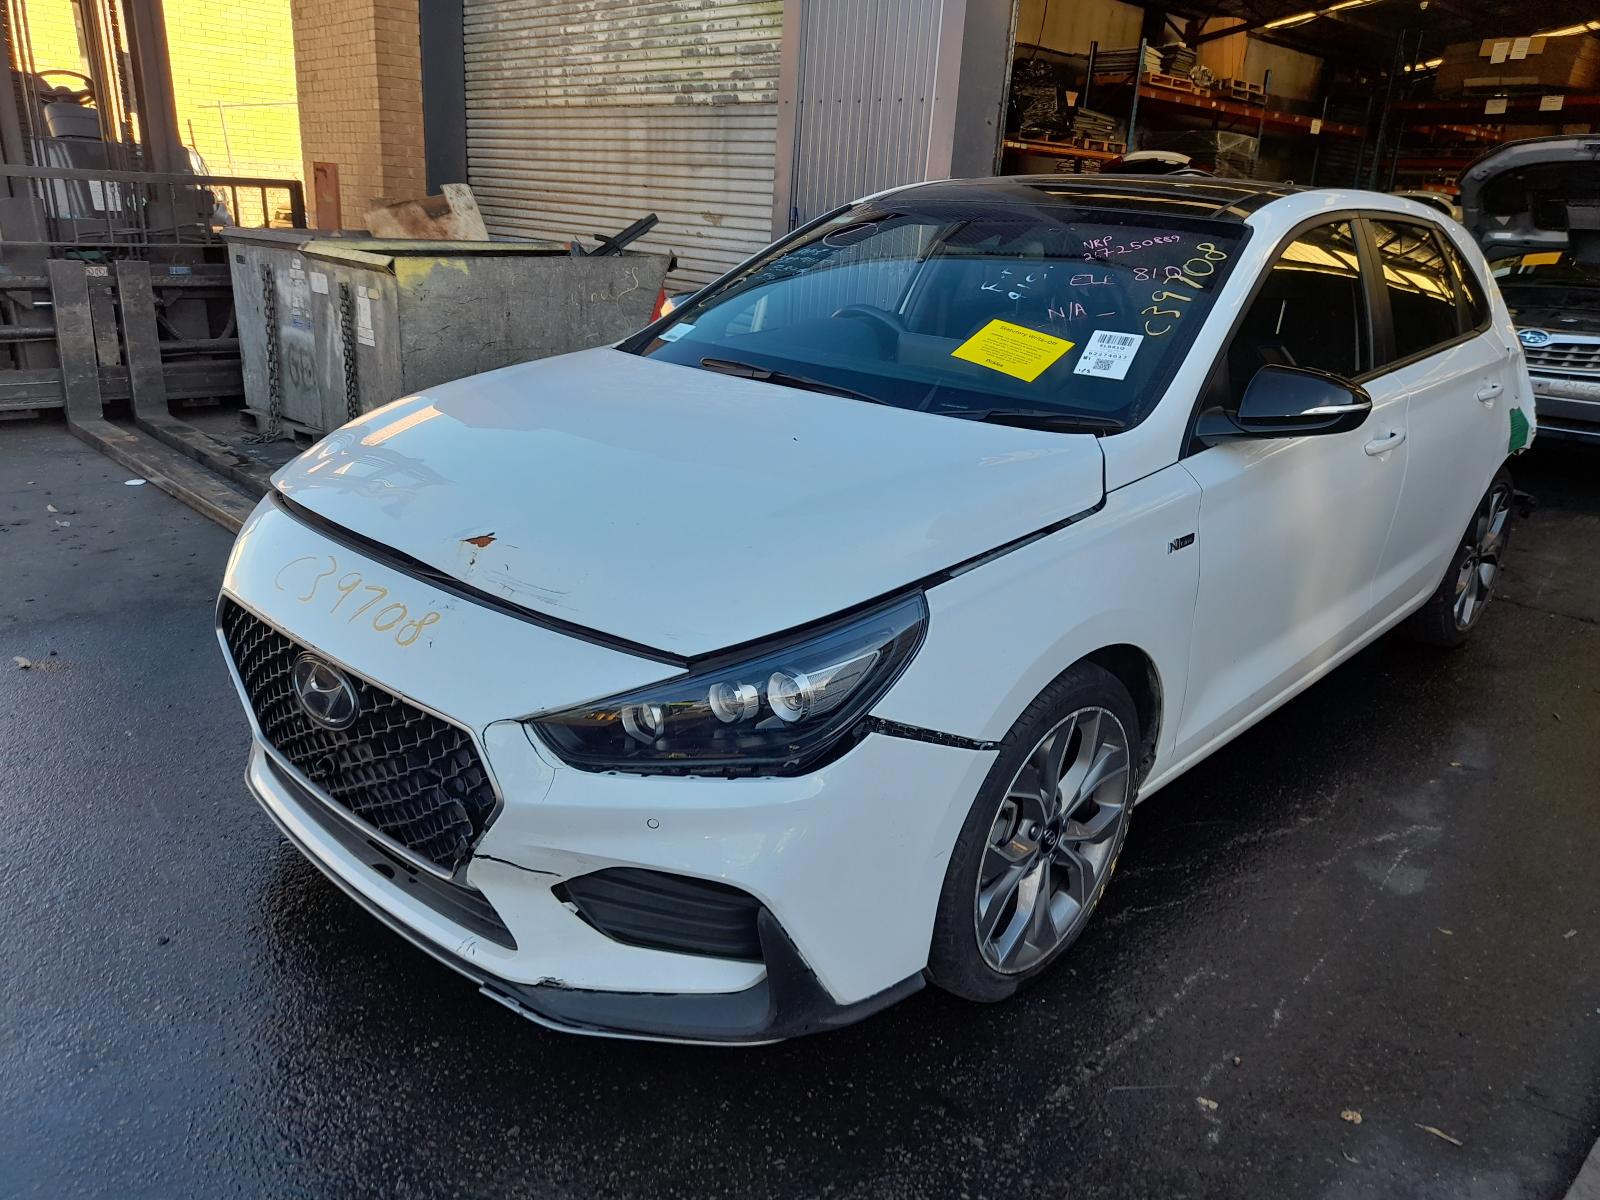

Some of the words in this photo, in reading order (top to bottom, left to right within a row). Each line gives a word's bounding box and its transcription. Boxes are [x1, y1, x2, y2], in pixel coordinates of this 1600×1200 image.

[1083, 235, 1113, 249] NRP
[1048, 301, 1088, 322] N/A
[274, 554, 442, 648] C39708
